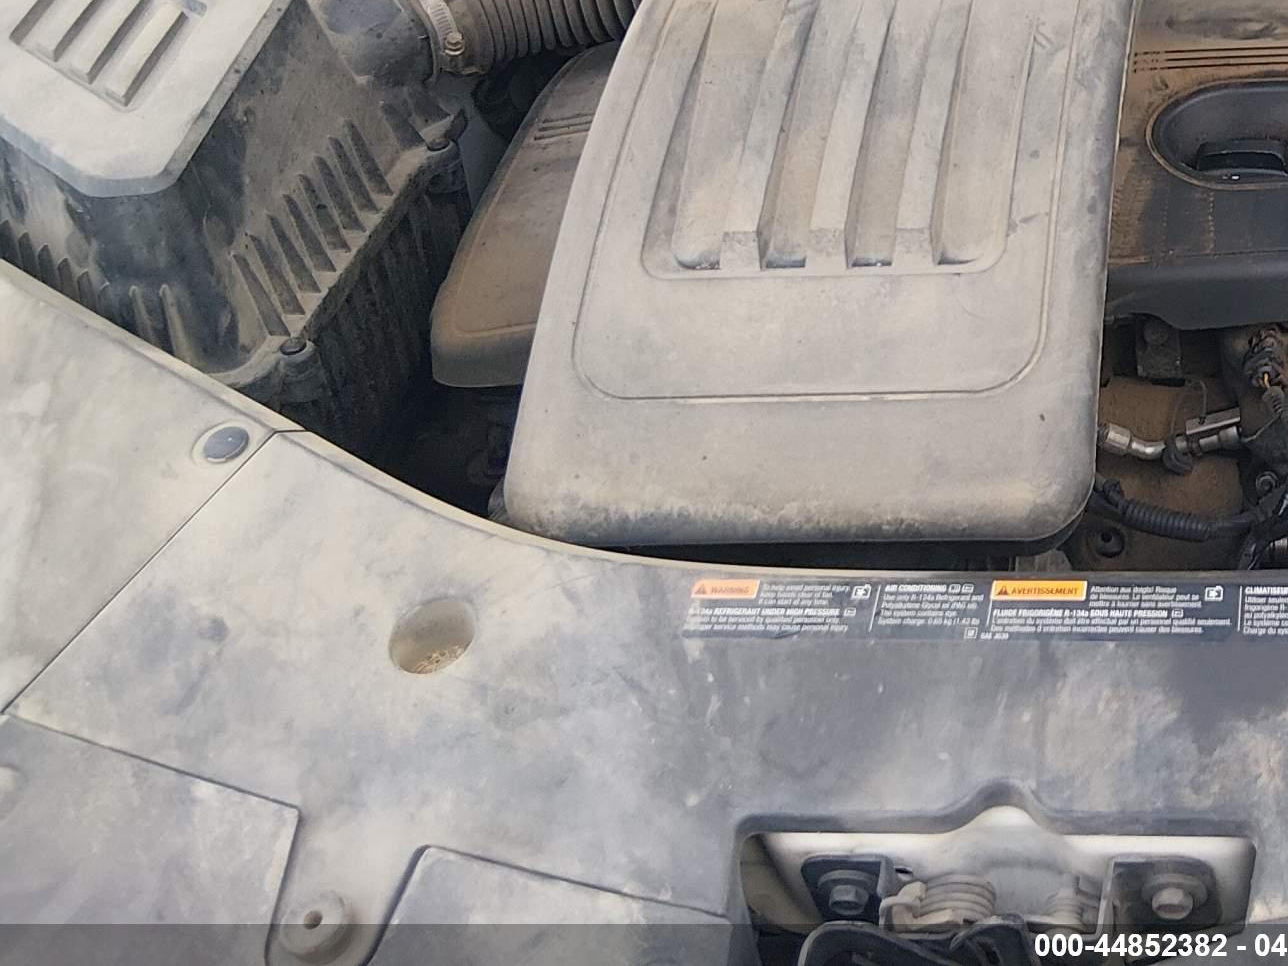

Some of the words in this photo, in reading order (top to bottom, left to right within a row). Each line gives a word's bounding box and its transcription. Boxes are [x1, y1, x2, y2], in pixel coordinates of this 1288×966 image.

[710, 586, 750, 594] WARNING
[885, 584, 898, 592] AIR
[898, 584, 947, 592] CONDITIONING
[896, 594, 910, 602] only
[936, 594, 970, 602] Refrigerant
[1134, 610, 1168, 618] PRESSION
